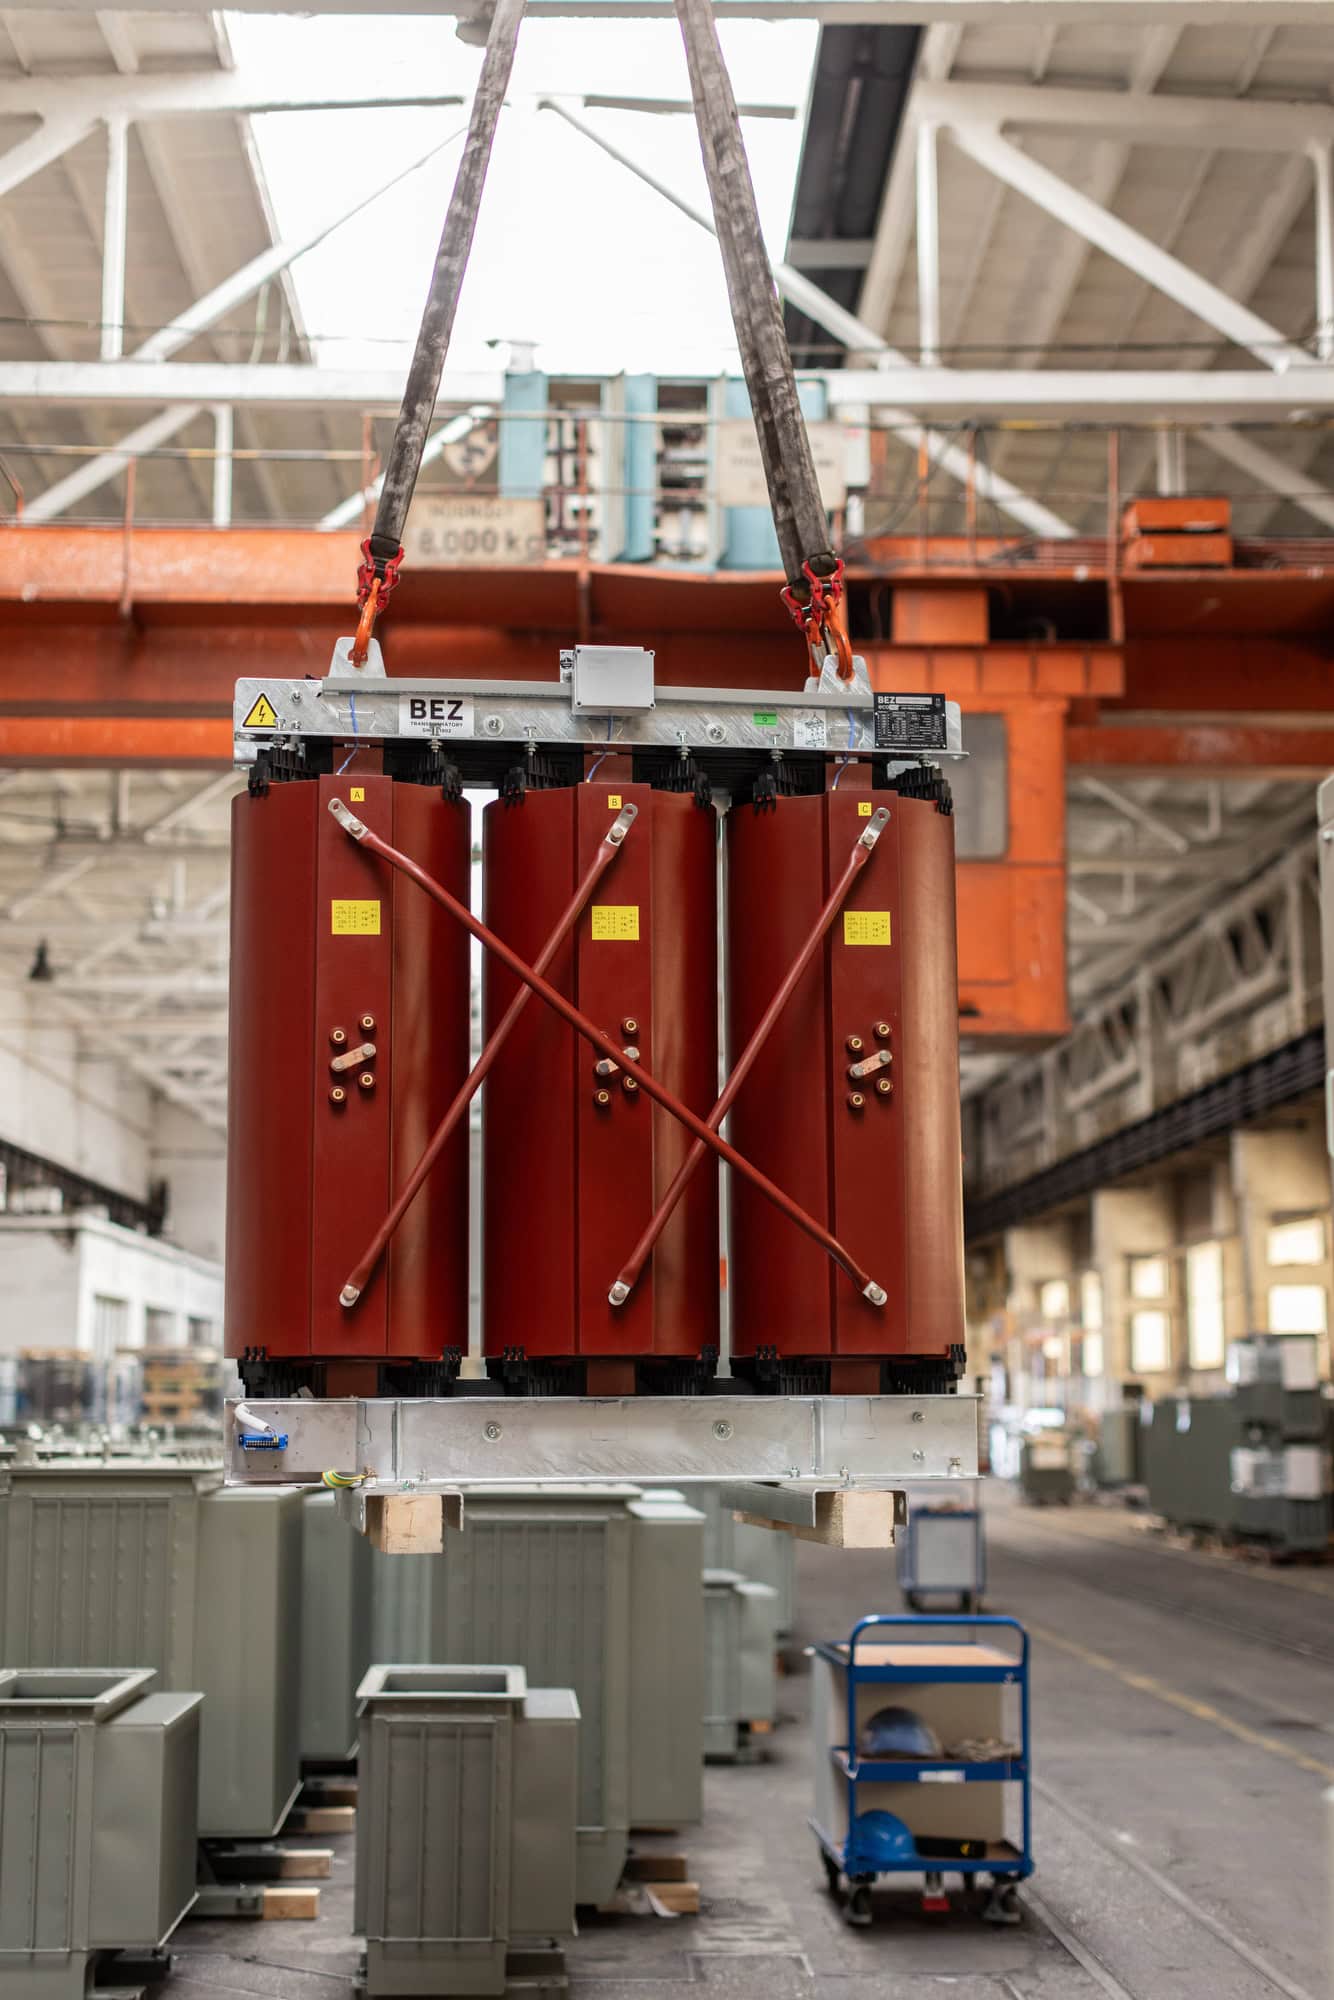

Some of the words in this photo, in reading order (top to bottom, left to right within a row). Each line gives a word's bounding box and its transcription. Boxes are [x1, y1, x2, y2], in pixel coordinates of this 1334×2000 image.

[878, 696, 896, 704] BEZ
[410, 698, 464, 720] BEZ
[354, 791, 361, 799] A
[611, 798, 618, 807] B
[862, 804, 869, 813] C
